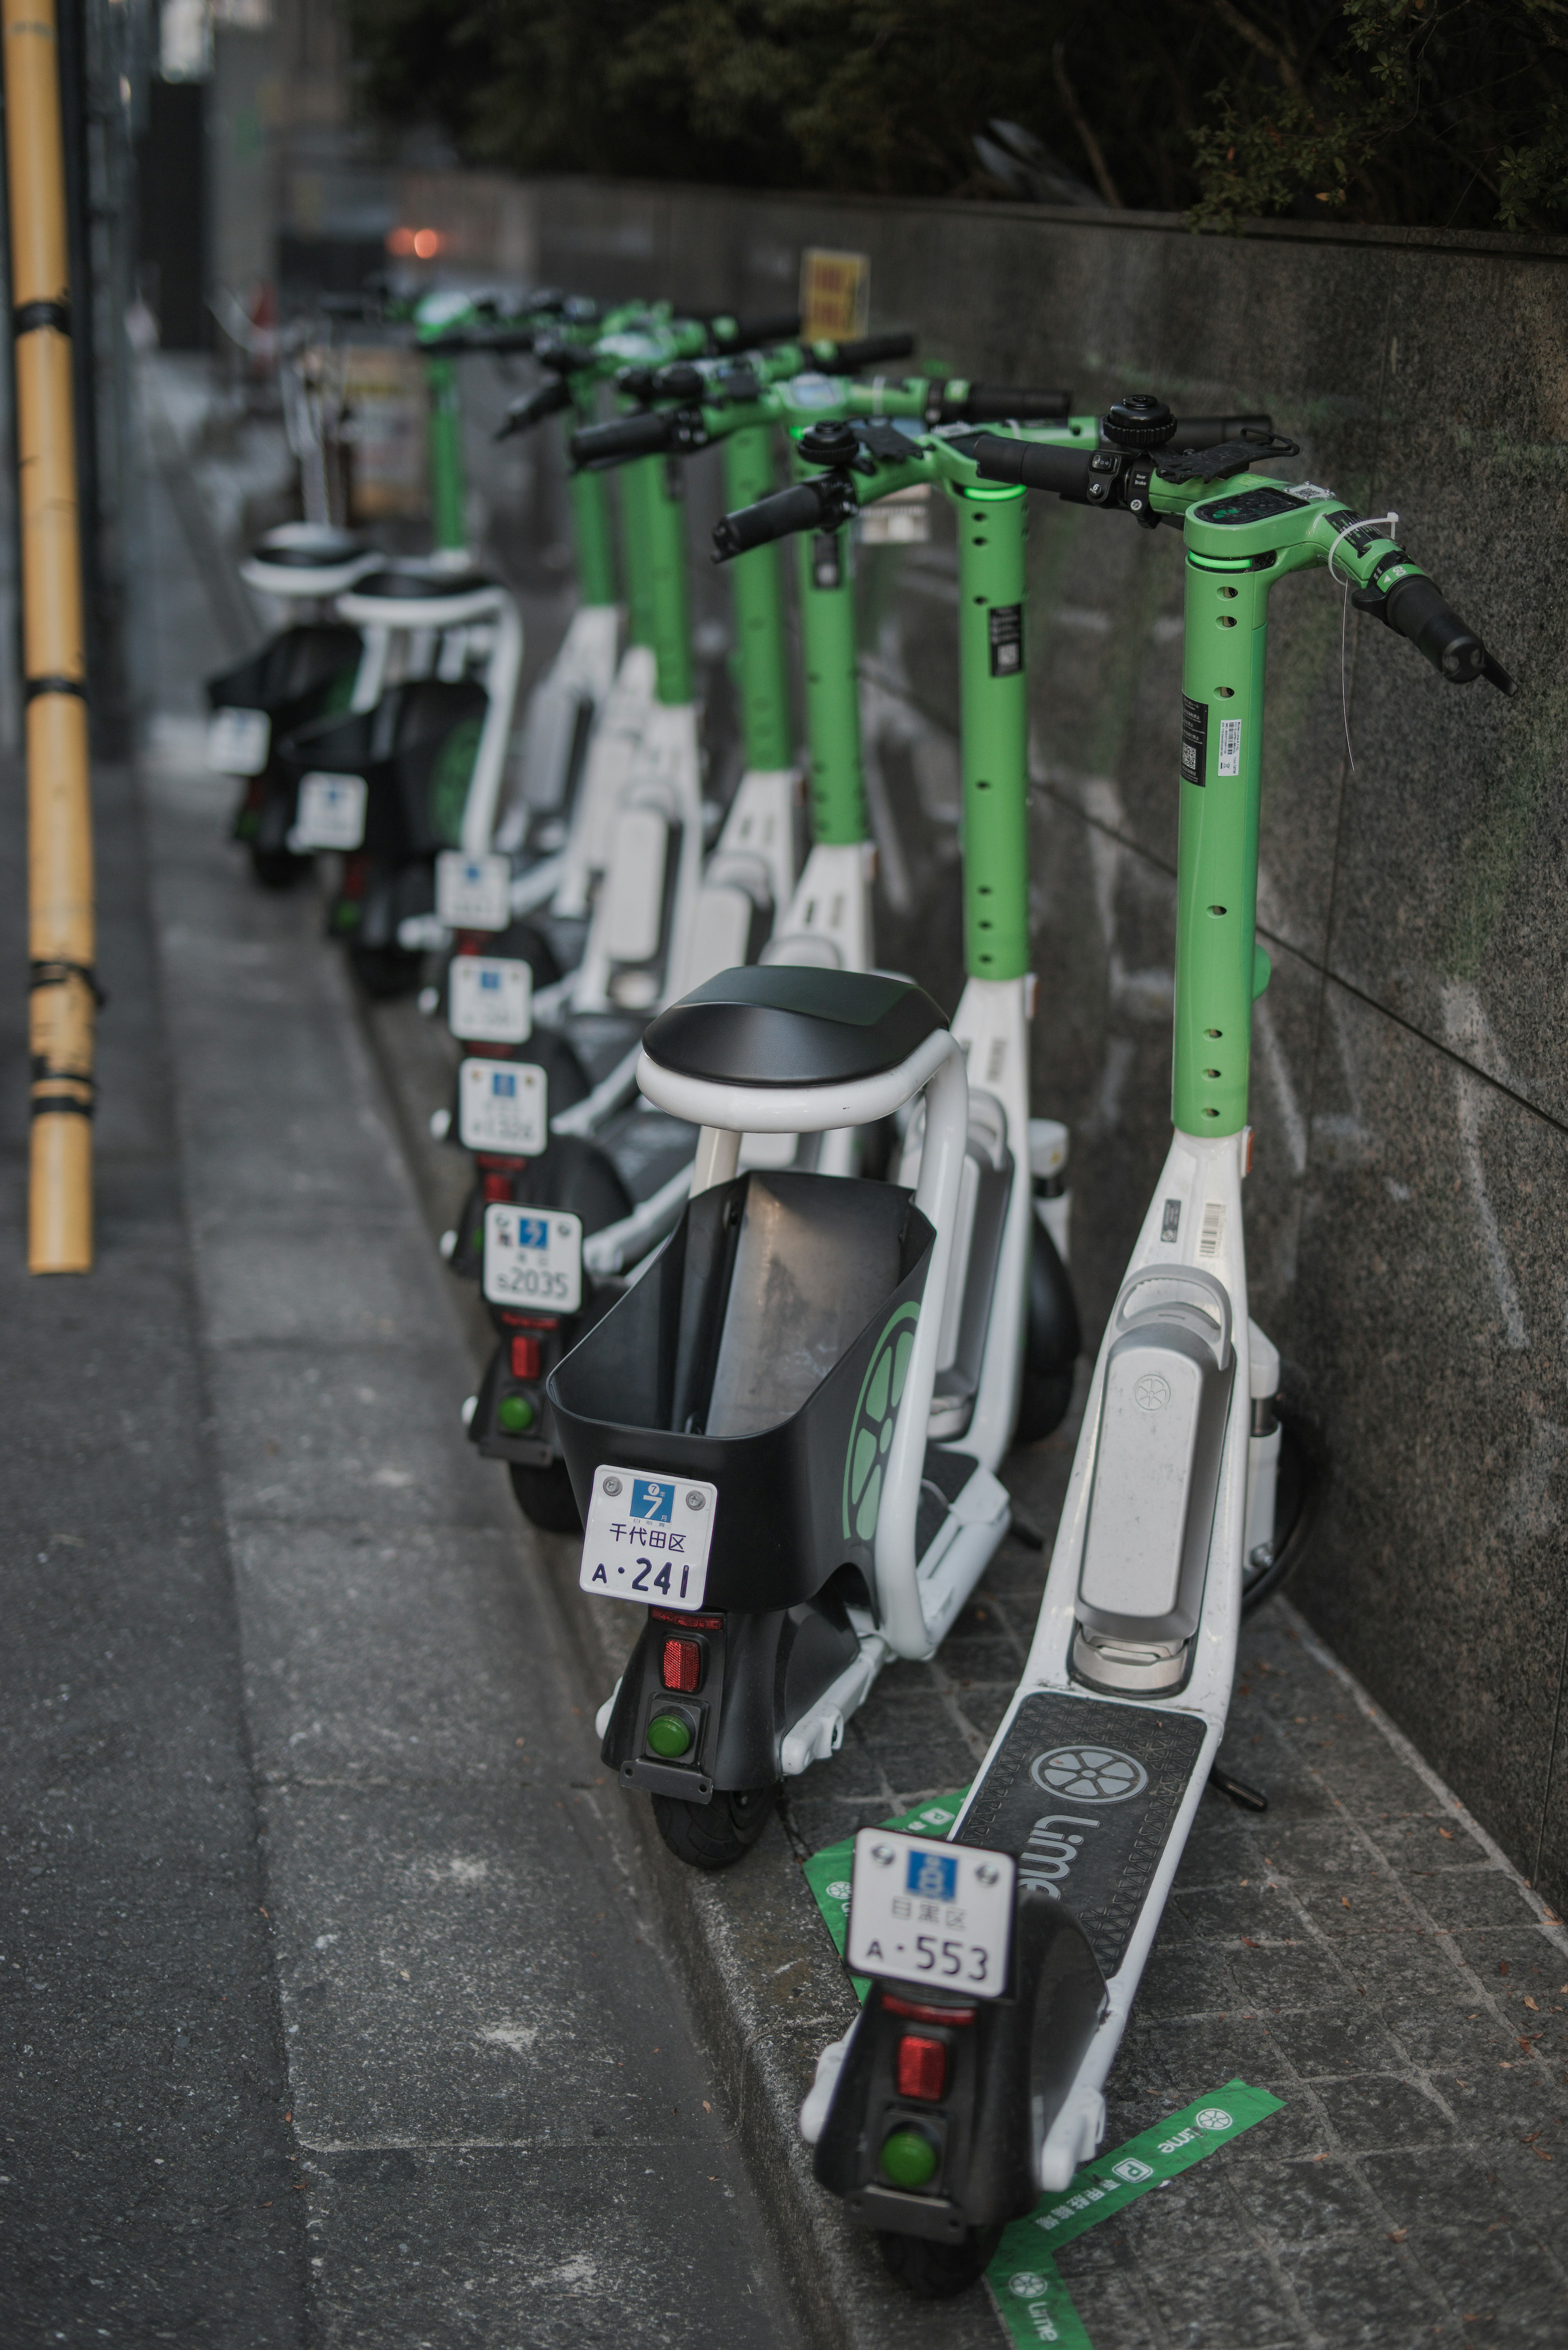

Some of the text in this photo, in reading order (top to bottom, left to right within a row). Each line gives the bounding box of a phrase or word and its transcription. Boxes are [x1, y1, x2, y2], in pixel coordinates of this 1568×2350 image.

[1392, 566, 1406, 576] GO
[609, 1523, 686, 1553] 千代田区
[892, 1895, 967, 1931] 目黒区
[1027, 2301, 1058, 2343] Lime
